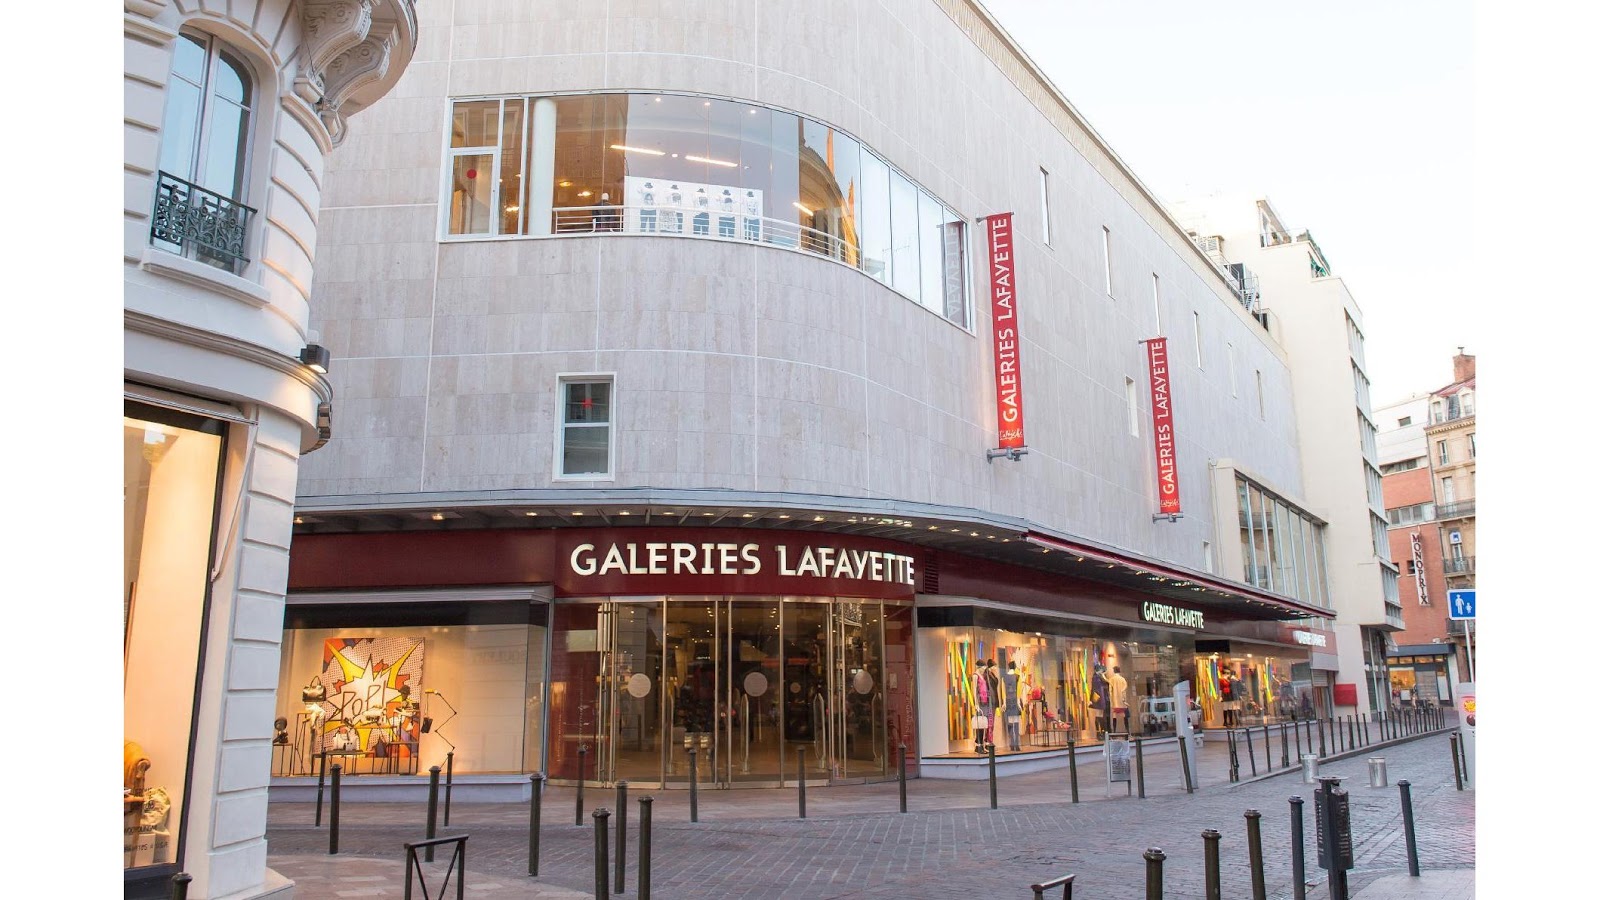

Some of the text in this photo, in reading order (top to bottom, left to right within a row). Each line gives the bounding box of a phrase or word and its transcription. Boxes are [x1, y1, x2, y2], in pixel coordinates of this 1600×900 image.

[992, 218, 1013, 322] LAFAYETTE
[999, 328, 1018, 423] GALERIES
[1151, 341, 1169, 419] LAFAYETTE
[1157, 423, 1175, 495] GALERIES
[570, 543, 915, 585] GALERIES LAFAYETTE
[1412, 534, 1428, 605] MONOPRIX
[1143, 601, 1204, 629] GALERIES LAFAYETTE
